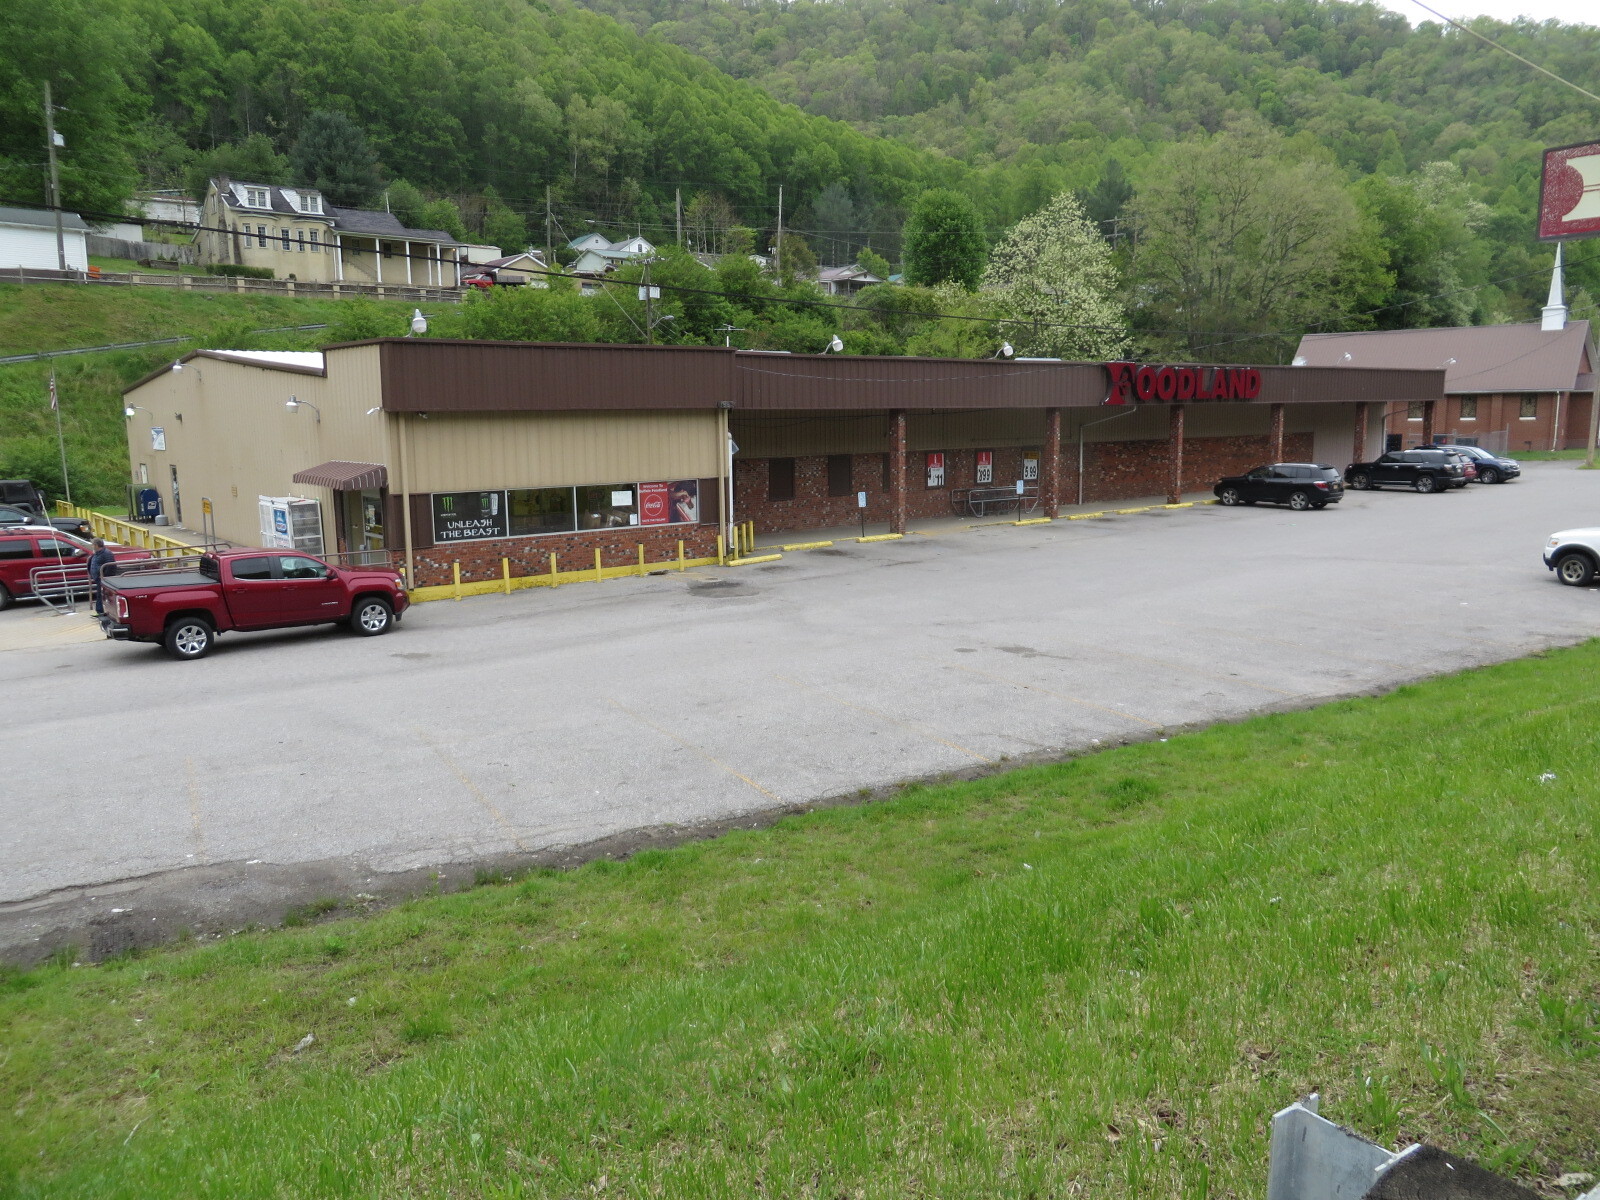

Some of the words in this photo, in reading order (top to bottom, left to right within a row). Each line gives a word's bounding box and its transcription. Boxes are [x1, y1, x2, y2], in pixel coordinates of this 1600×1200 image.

[1104, 362, 1261, 405] FOODLAND
[447, 519, 493, 529] UNLEASH
[440, 530, 462, 539] THE
[463, 527, 500, 537] BEAST
